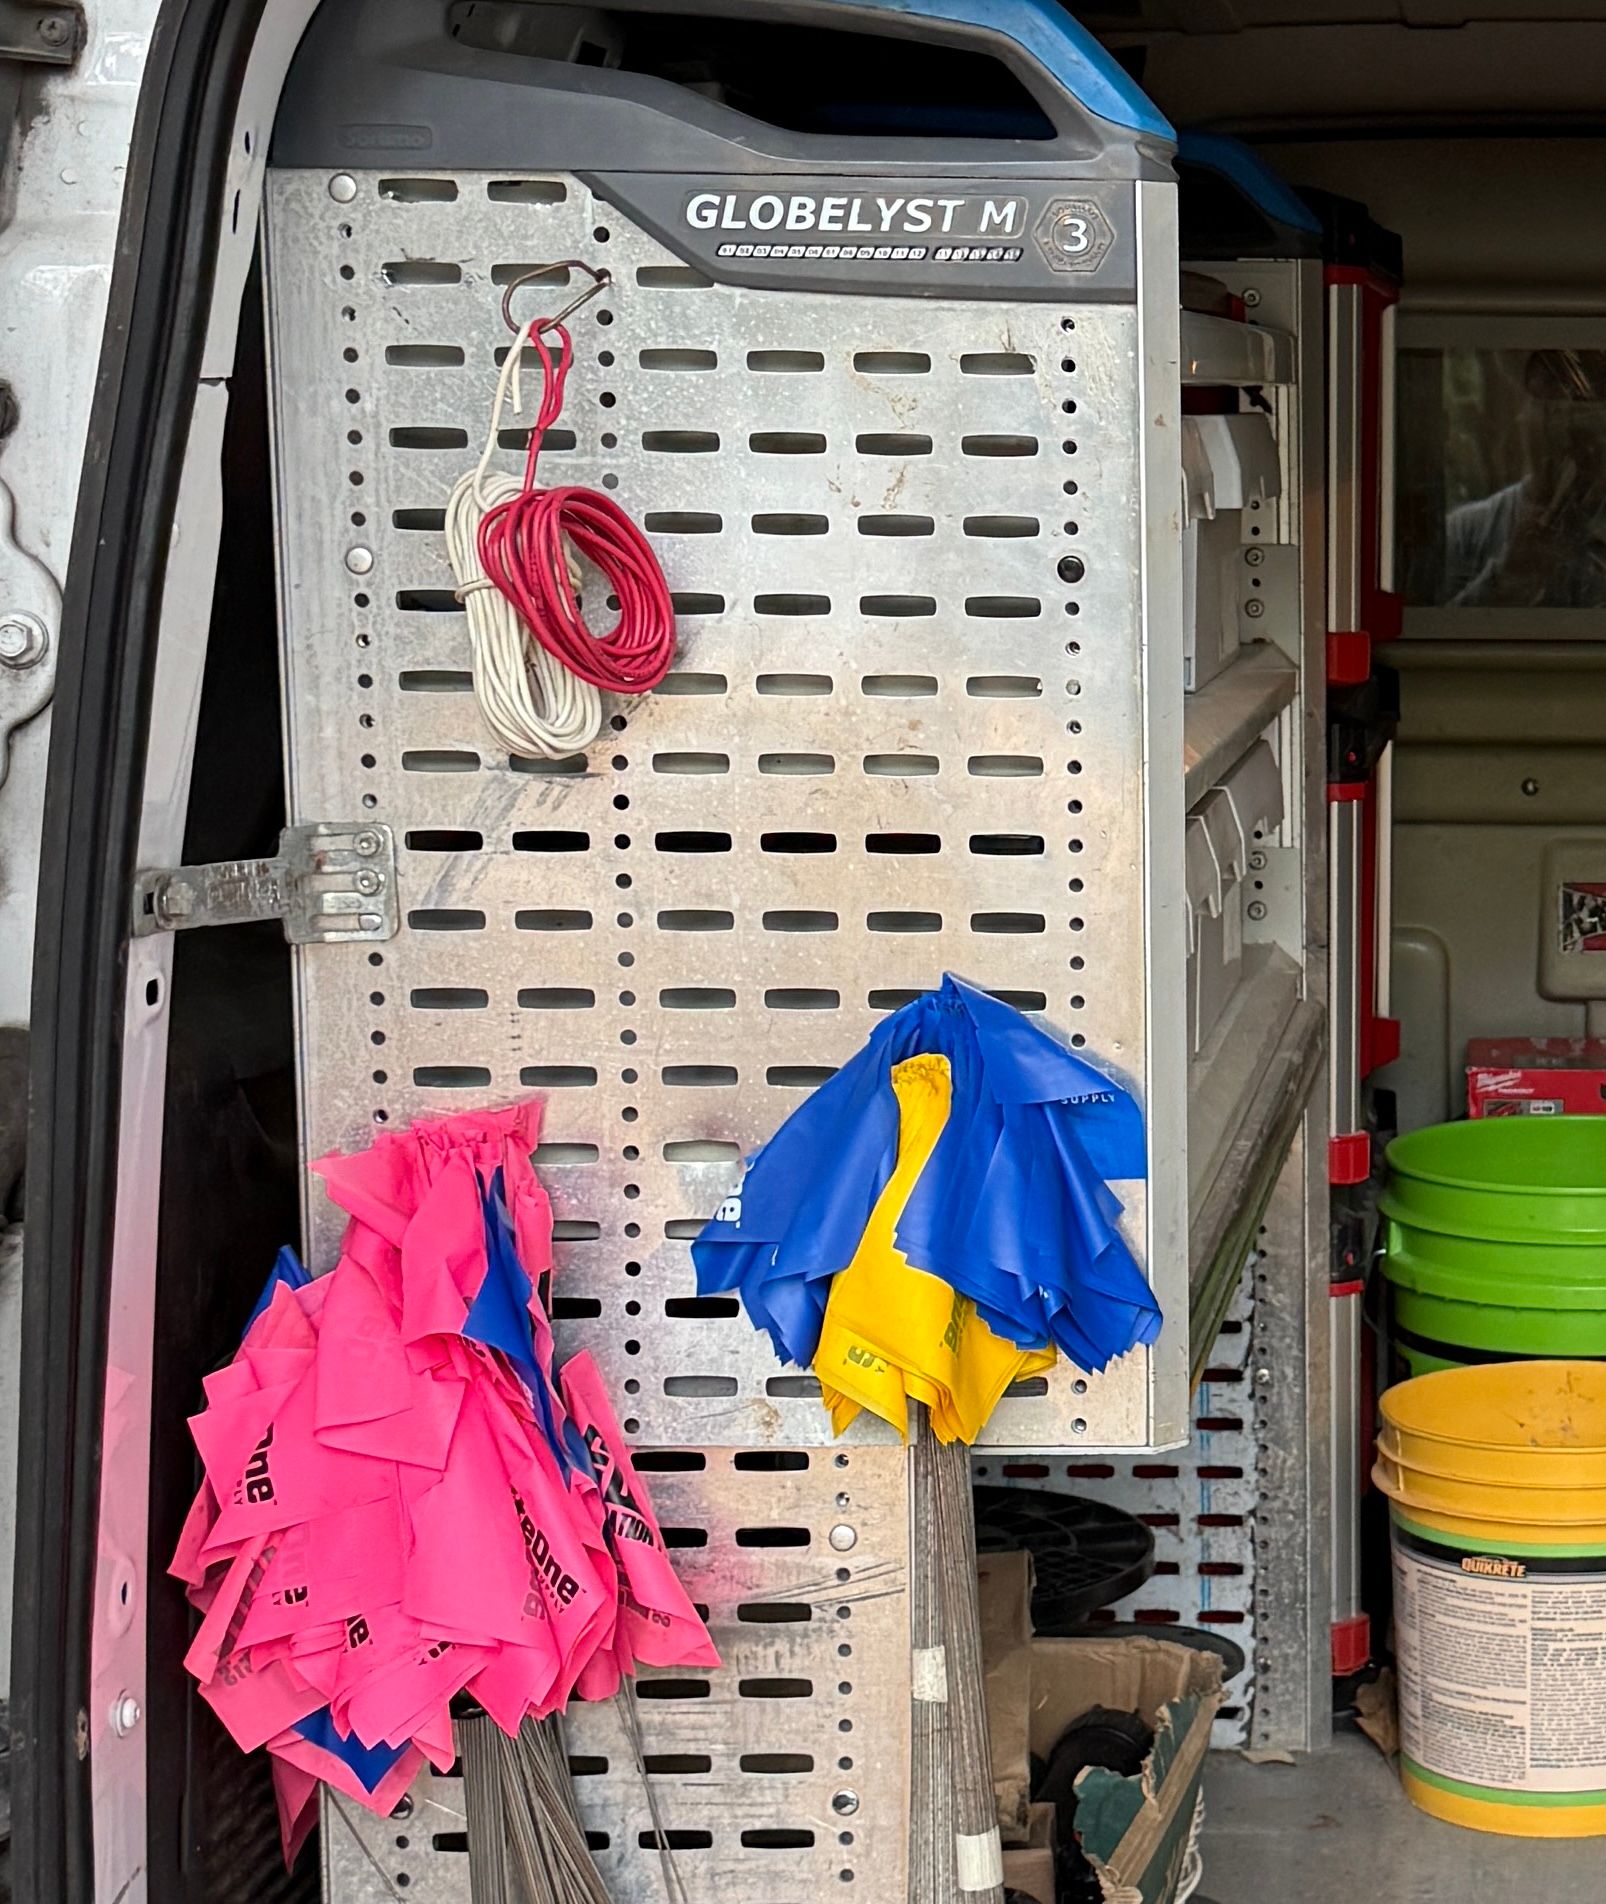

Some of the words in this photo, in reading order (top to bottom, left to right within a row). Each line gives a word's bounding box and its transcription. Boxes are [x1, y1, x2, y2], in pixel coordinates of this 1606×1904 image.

[686, 194, 965, 233] GLOBELYST
[980, 200, 1018, 234] M
[1063, 217, 1089, 253] 3
[1462, 1558, 1527, 1577] QUIKRETE
